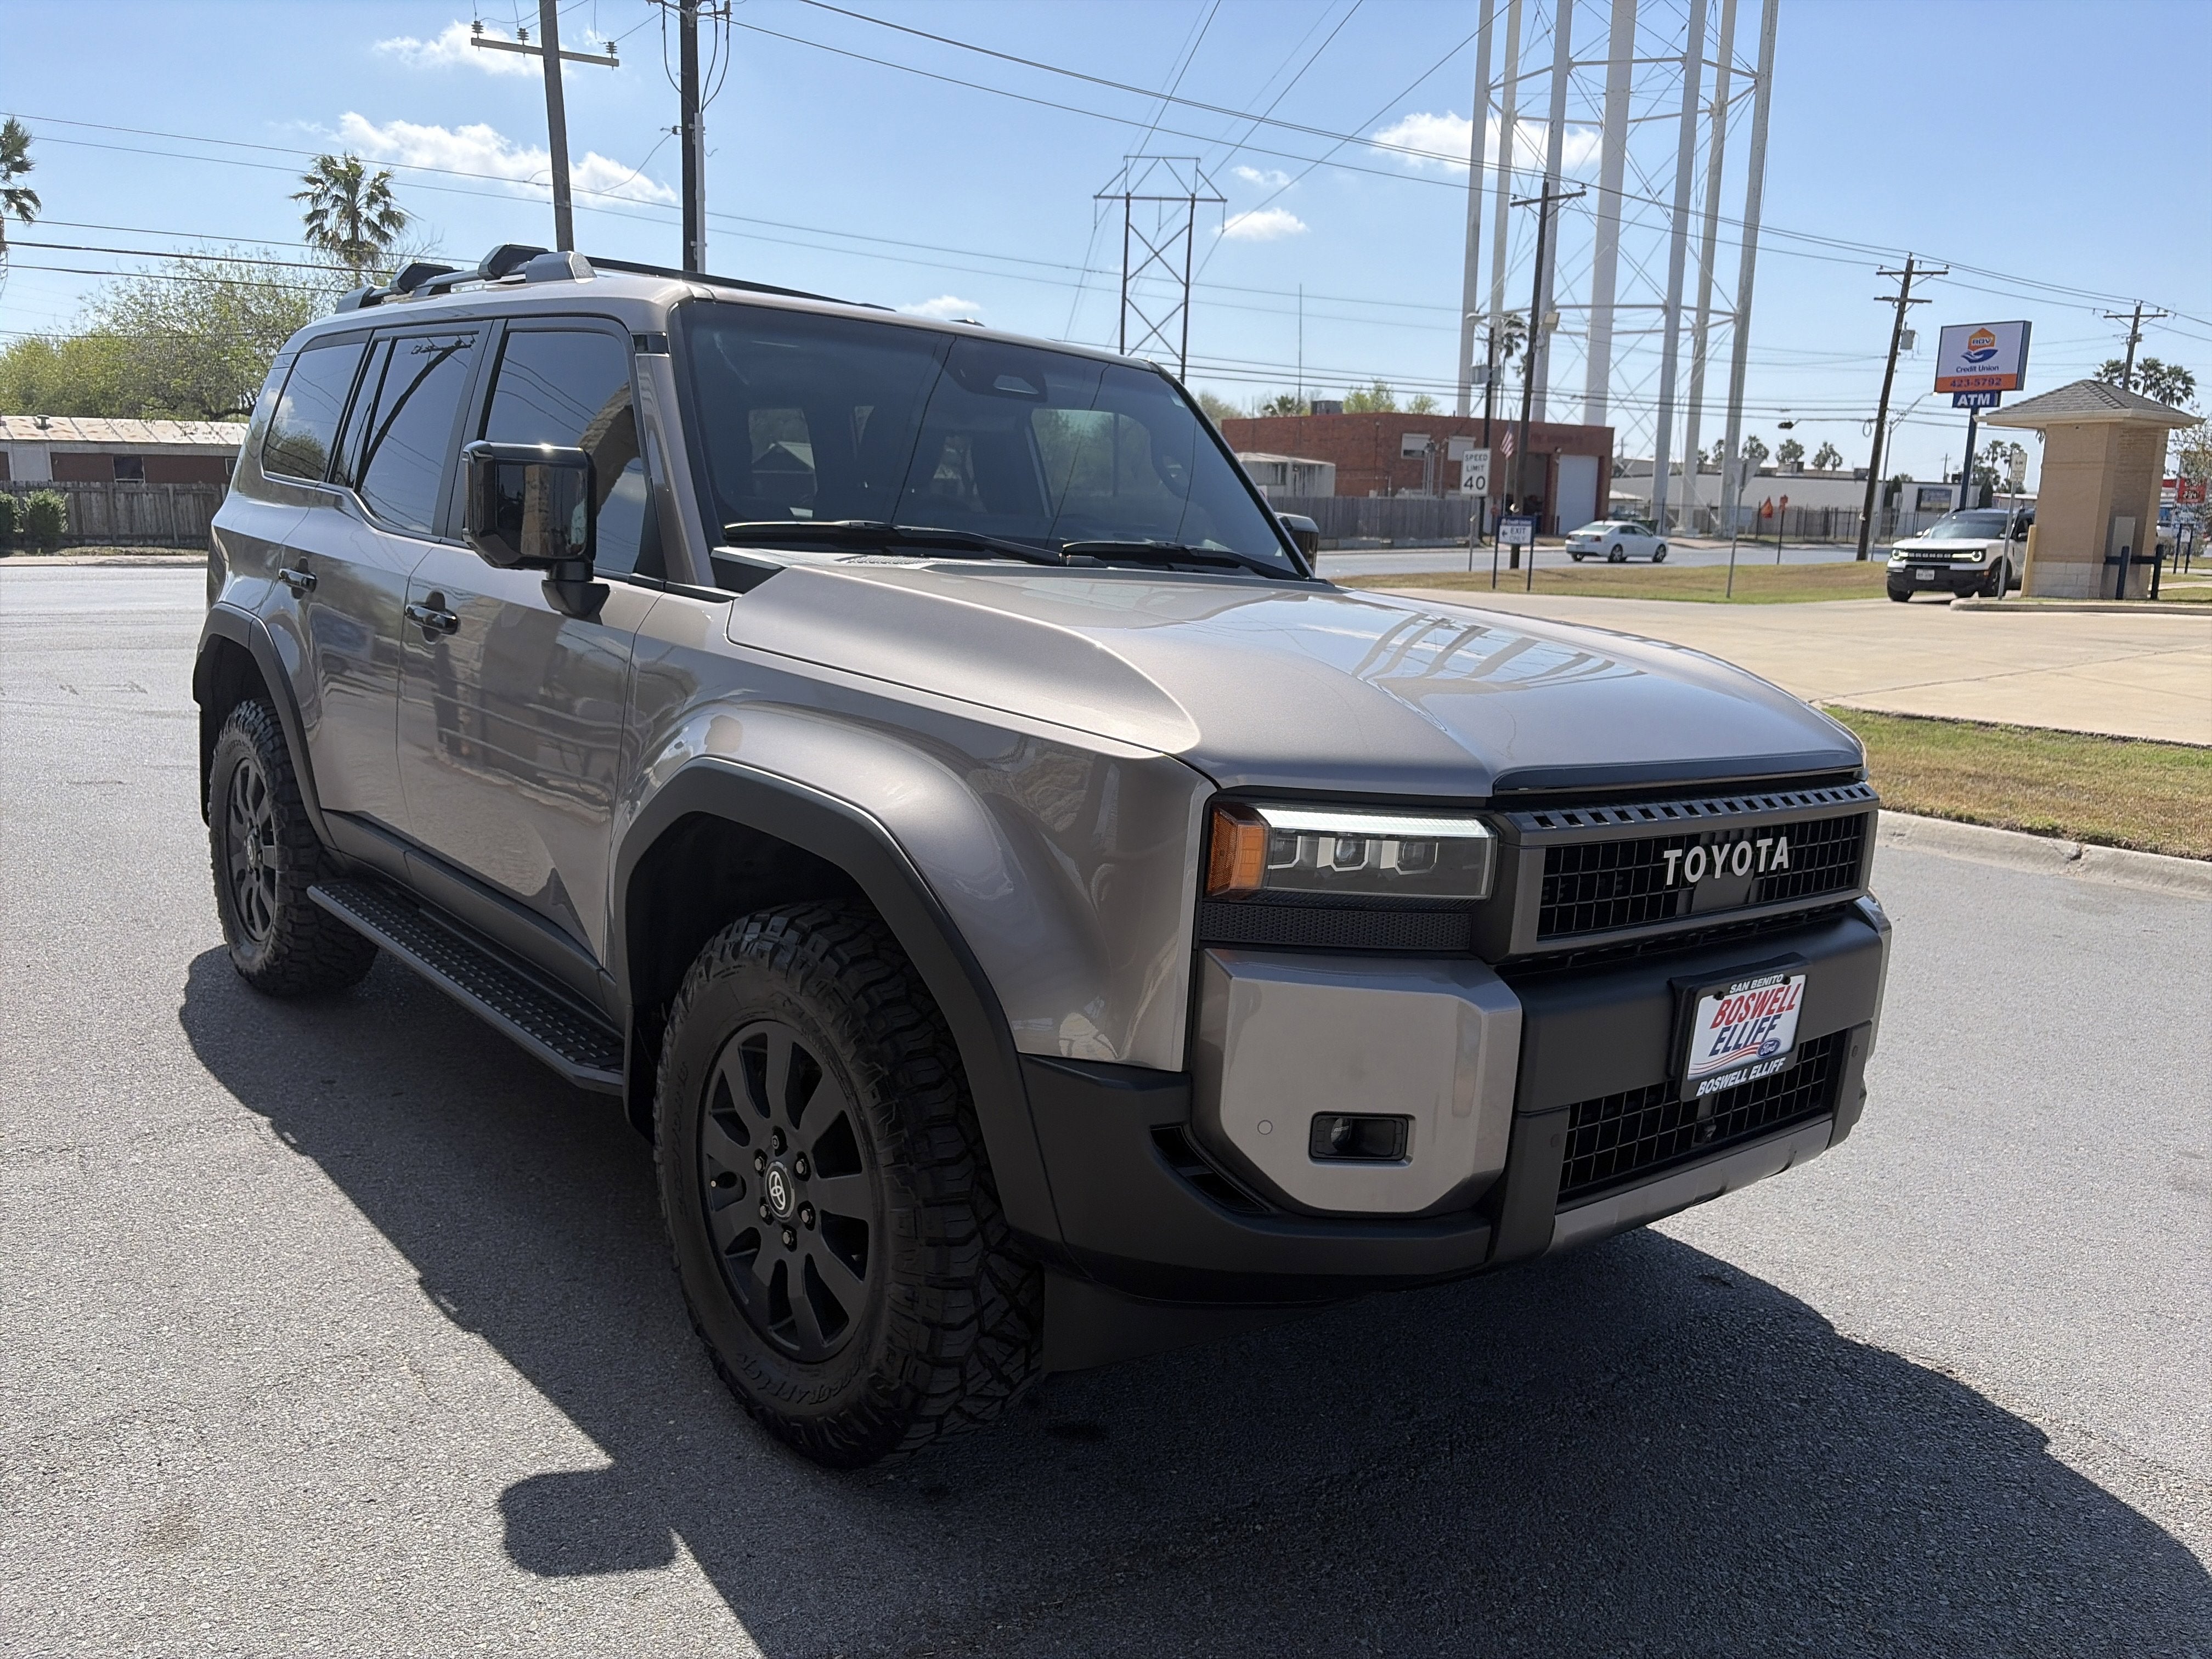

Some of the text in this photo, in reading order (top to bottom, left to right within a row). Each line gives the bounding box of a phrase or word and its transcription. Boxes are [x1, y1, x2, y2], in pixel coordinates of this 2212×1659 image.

[1956, 365, 1976, 374] Credit
[1950, 377, 2002, 387] 423-5792
[1957, 393, 1990, 407] ATM
[1463, 475, 1486, 490] 40
[1663, 836, 1789, 885] TOYOTA
[1729, 973, 1784, 994] SAN BENITO
[1709, 983, 1802, 1029] BOSWELL
[1708, 1013, 1783, 1057] ELLIFF
[1760, 1040, 1778, 1055] Ford
[1696, 1057, 1786, 1097] BOSWELL ELLIFF
